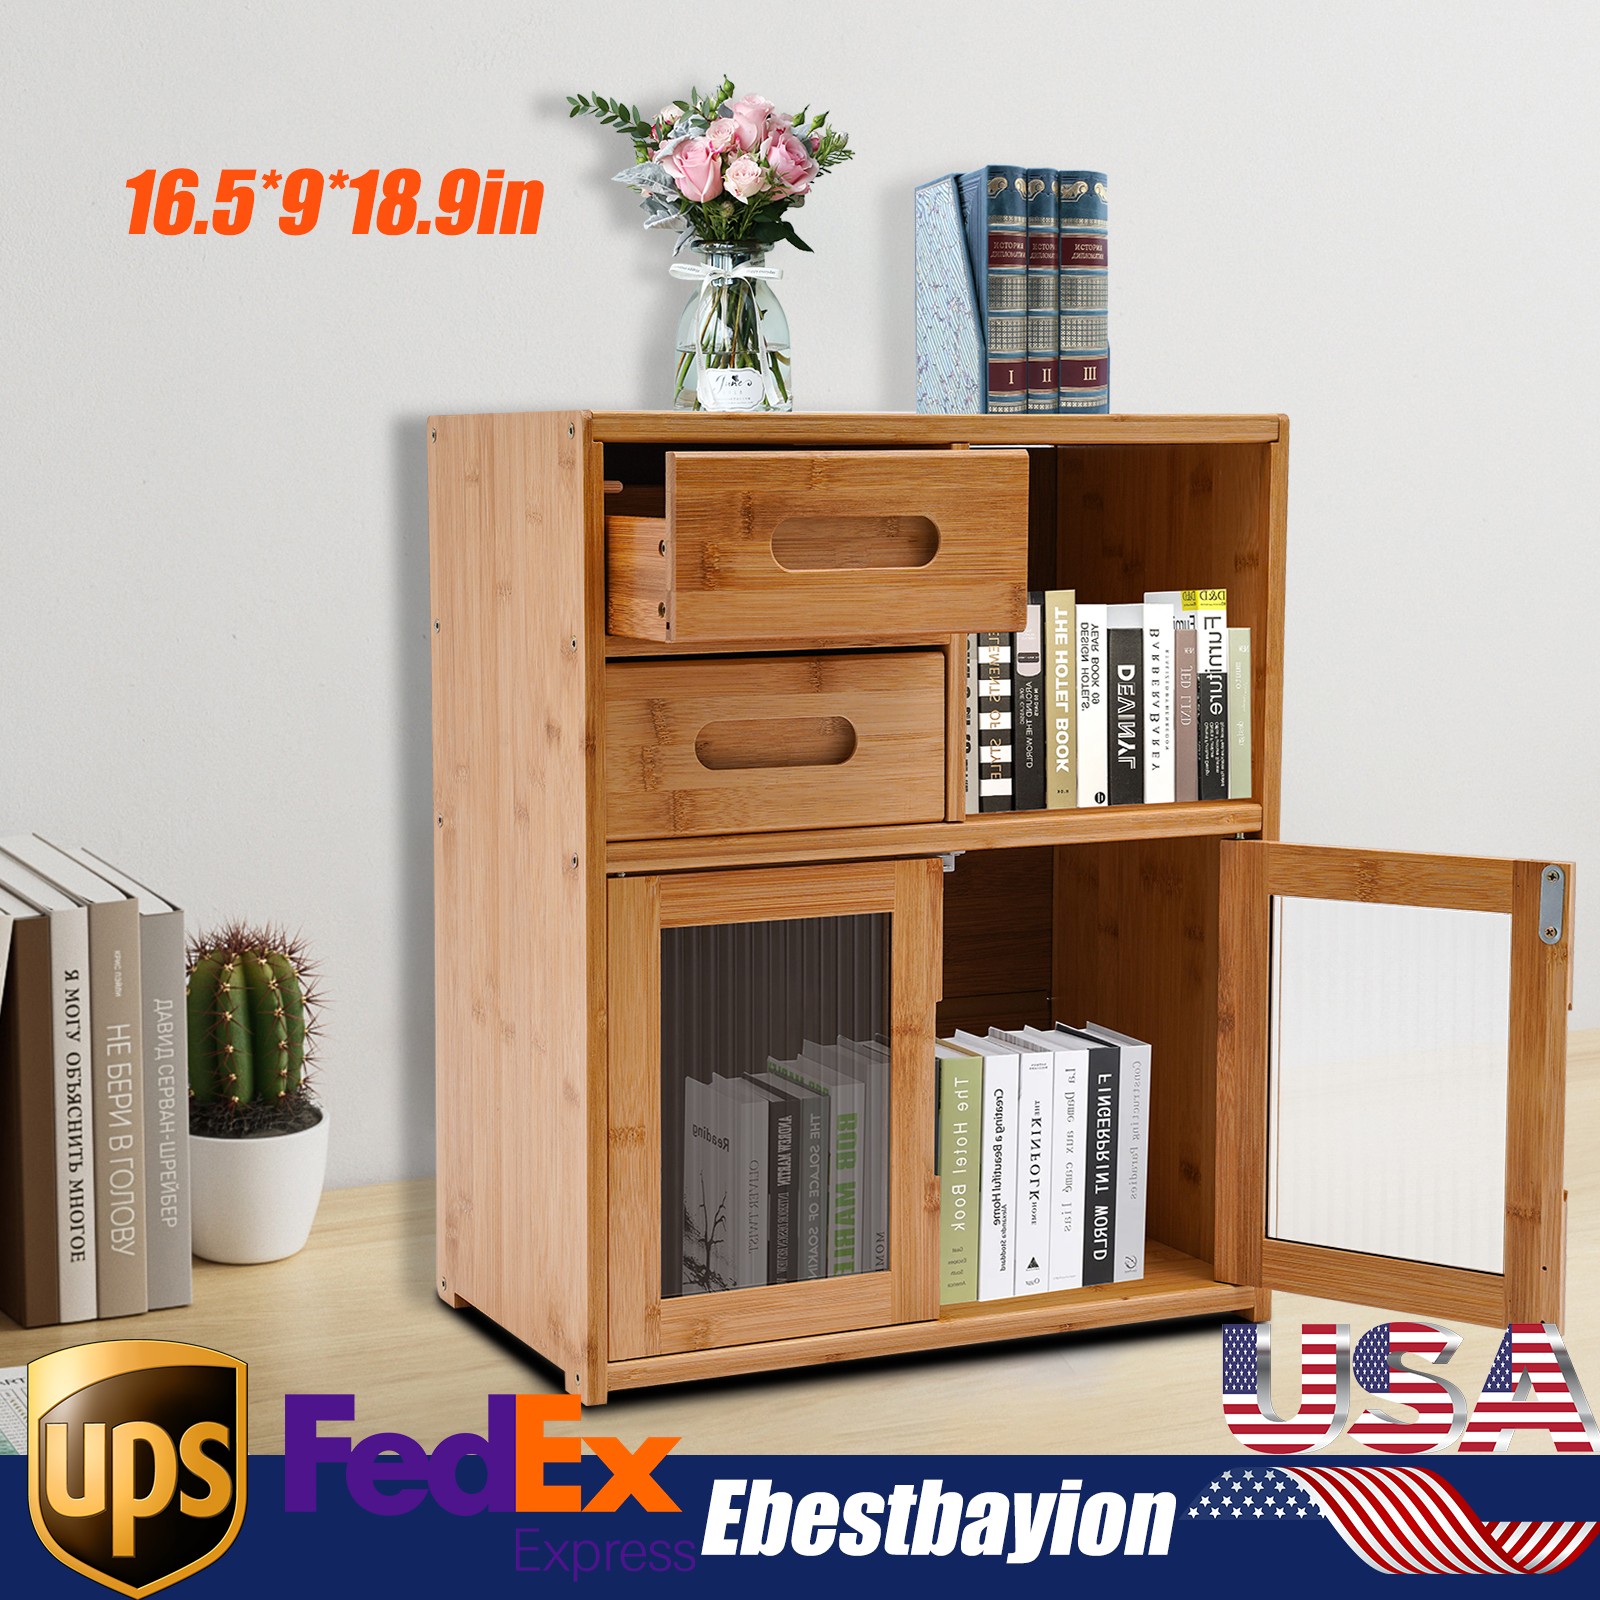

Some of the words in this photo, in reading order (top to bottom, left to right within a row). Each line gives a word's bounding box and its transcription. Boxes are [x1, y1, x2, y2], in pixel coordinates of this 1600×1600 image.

[1008, 370, 1015, 384] I
[1042, 368, 1052, 383] II
[1083, 366, 1097, 381] III
[64, 969, 79, 981] Я
[65, 988, 81, 1043] МОГУ
[106, 1024, 131, 1056] НЕ
[153, 998, 174, 1061] ДАВИД
[66, 1052, 85, 1173] ОБЪЯСНИТЬ
[107, 1062, 133, 1128] БЕРИ
[108, 1134, 133, 1150] В
[158, 1063, 180, 1228] СЕРВАН-ШРЕЙБЕР
[69, 1178, 86, 1263] МНОГОЕ
[110, 1157, 136, 1256] ГОЛОВУ
